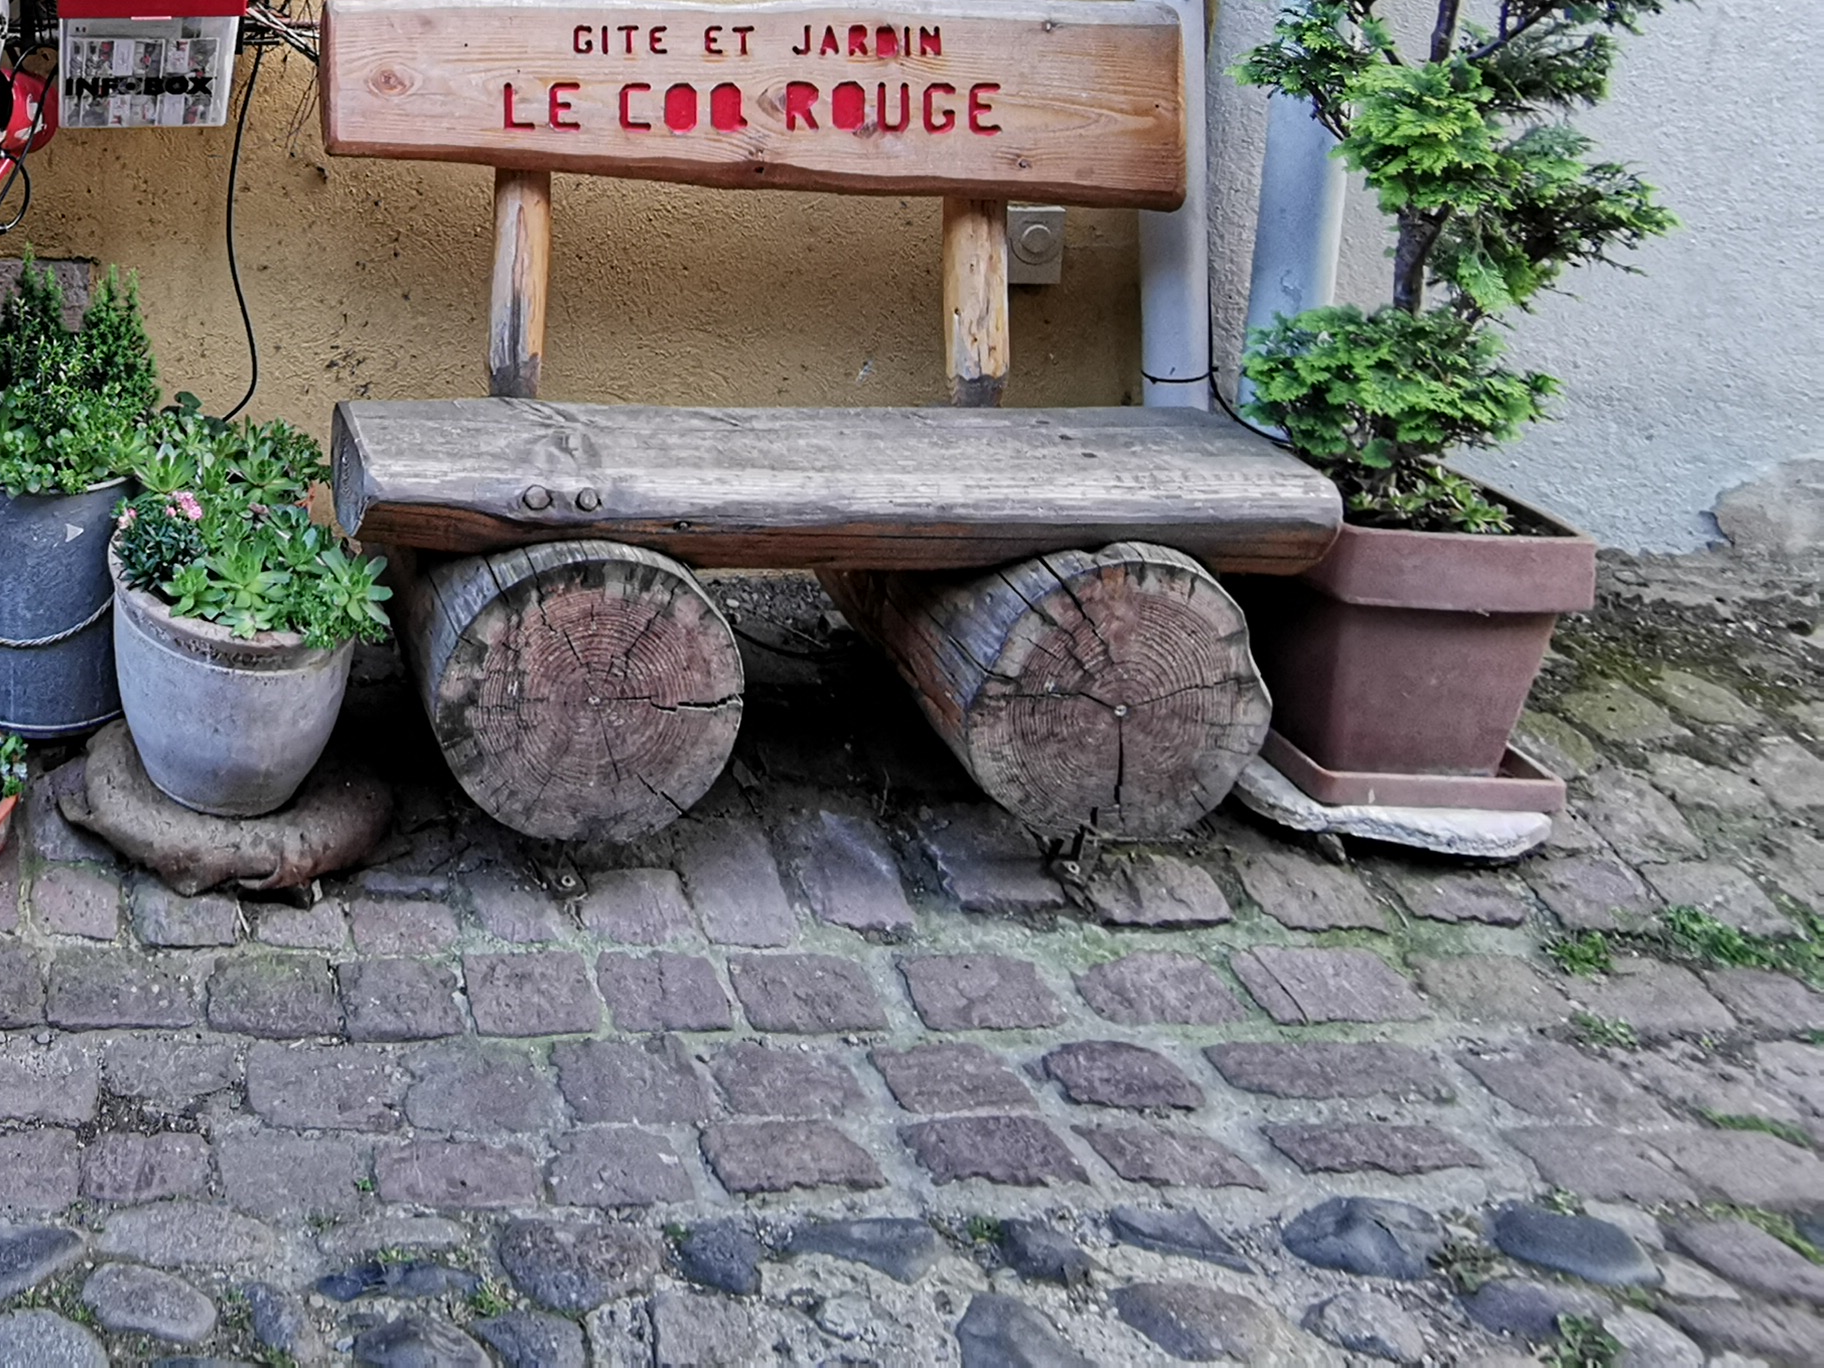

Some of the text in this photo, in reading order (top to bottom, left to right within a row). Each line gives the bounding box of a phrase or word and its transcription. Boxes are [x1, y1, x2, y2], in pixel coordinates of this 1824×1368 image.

[573, 24, 943, 59] GITE ET JARDIN
[503, 80, 1003, 136] LE COQ ROUGE
